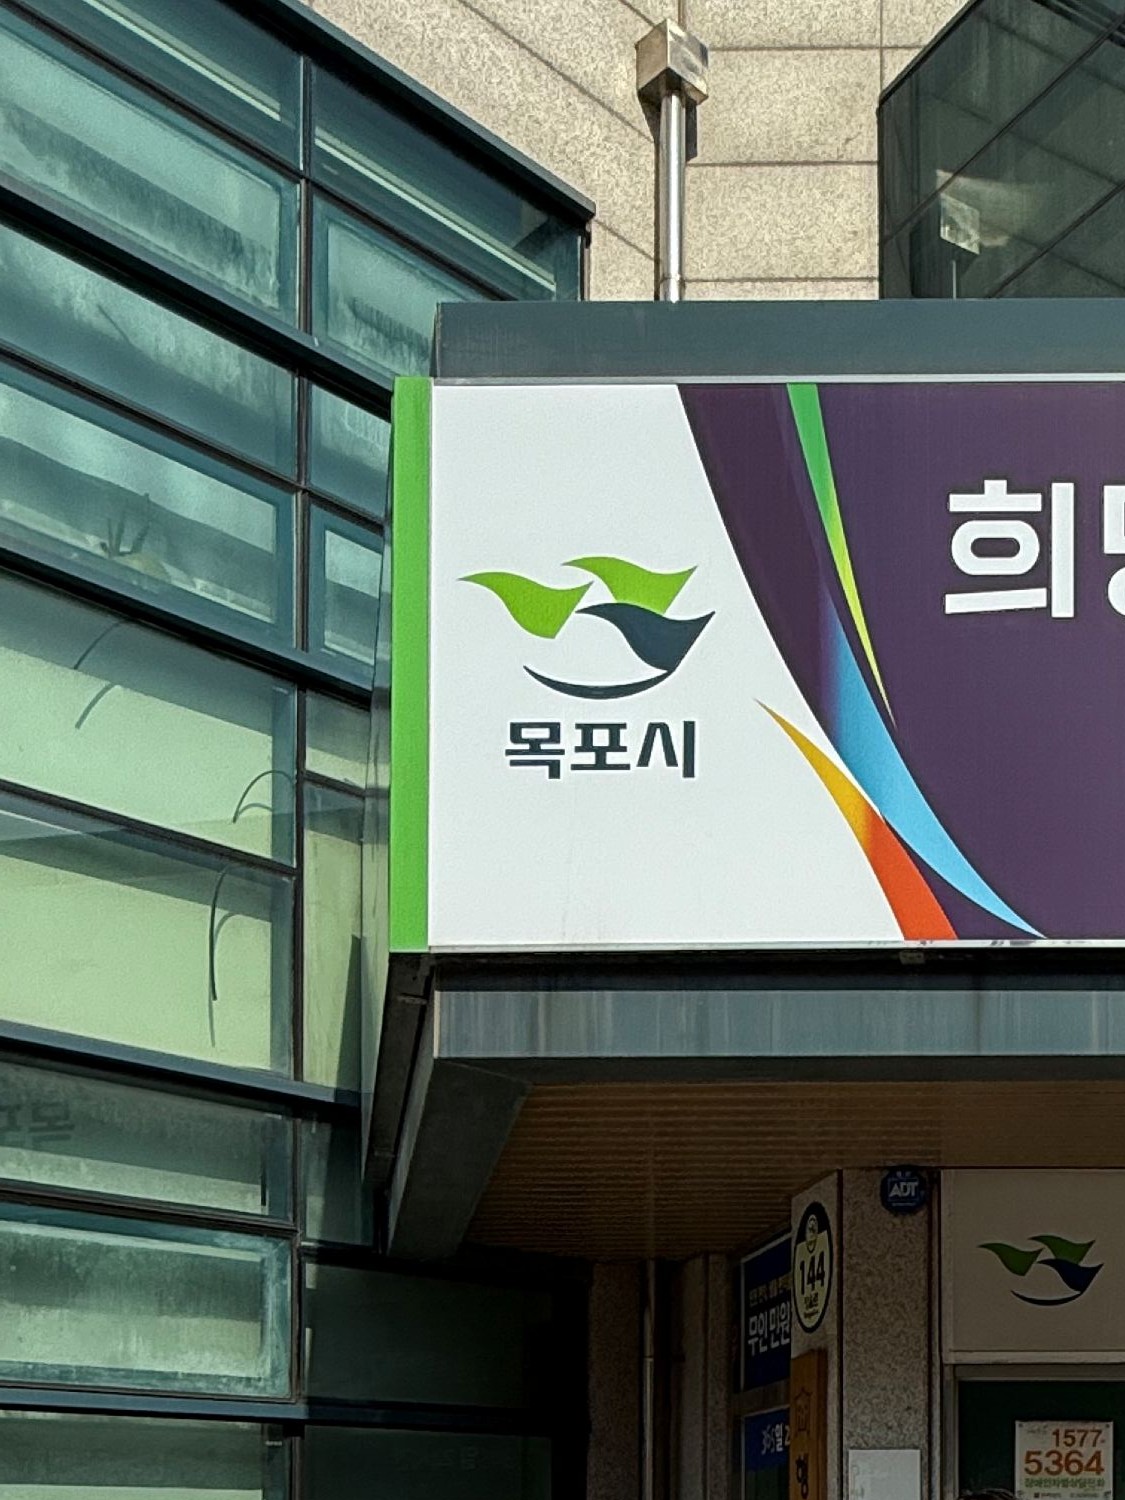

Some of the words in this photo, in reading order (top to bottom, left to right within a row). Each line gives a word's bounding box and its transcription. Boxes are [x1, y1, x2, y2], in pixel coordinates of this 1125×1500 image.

[504, 719, 698, 780] 목포시
[888, 1181, 919, 1199] ADT
[799, 1250, 826, 1297] 144
[1024, 1449, 1105, 1476] 5364
